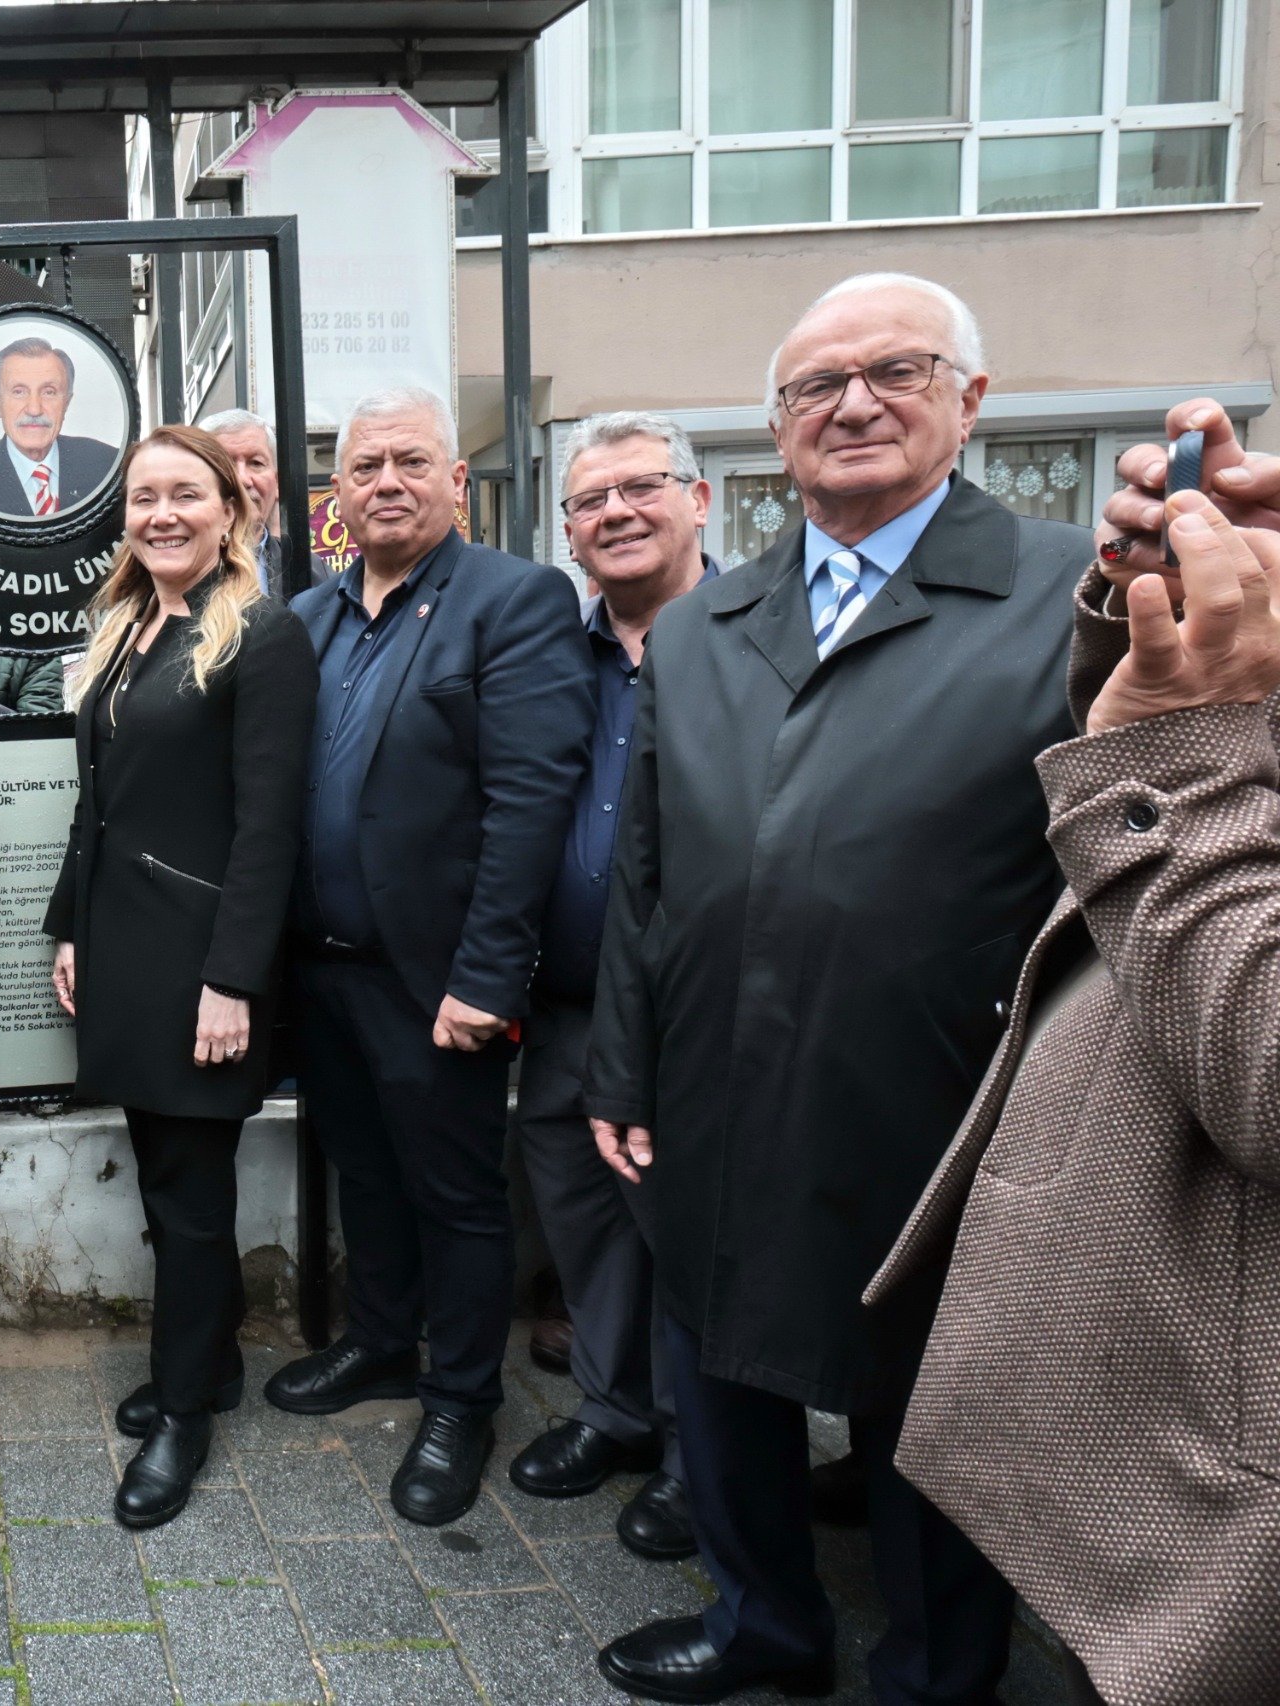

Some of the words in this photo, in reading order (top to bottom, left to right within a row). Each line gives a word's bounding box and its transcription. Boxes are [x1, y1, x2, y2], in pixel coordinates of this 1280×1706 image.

[301, 312, 329, 330] 232
[334, 311, 362, 330] 285
[367, 311, 384, 329] 51
[390, 310, 410, 329] 00
[333, 336, 363, 354] 706
[367, 335, 386, 353] 20
[391, 335, 410, 353] 82
[74, 530, 127, 585] ÜN
[49, 780, 65, 790] VE
[14, 841, 67, 852] bünyesinde
[9, 862, 60, 873] 1992-2001
[11, 884, 56, 894] hizmetler
[14, 896, 50, 907] öğrenci
[5, 918, 41, 927] kültürel
[18, 938, 44, 949] gönül
[14, 1012, 43, 1021] Konak
[13, 1023, 26, 1032] 56
[27, 1021, 63, 1031] Sokak'a
